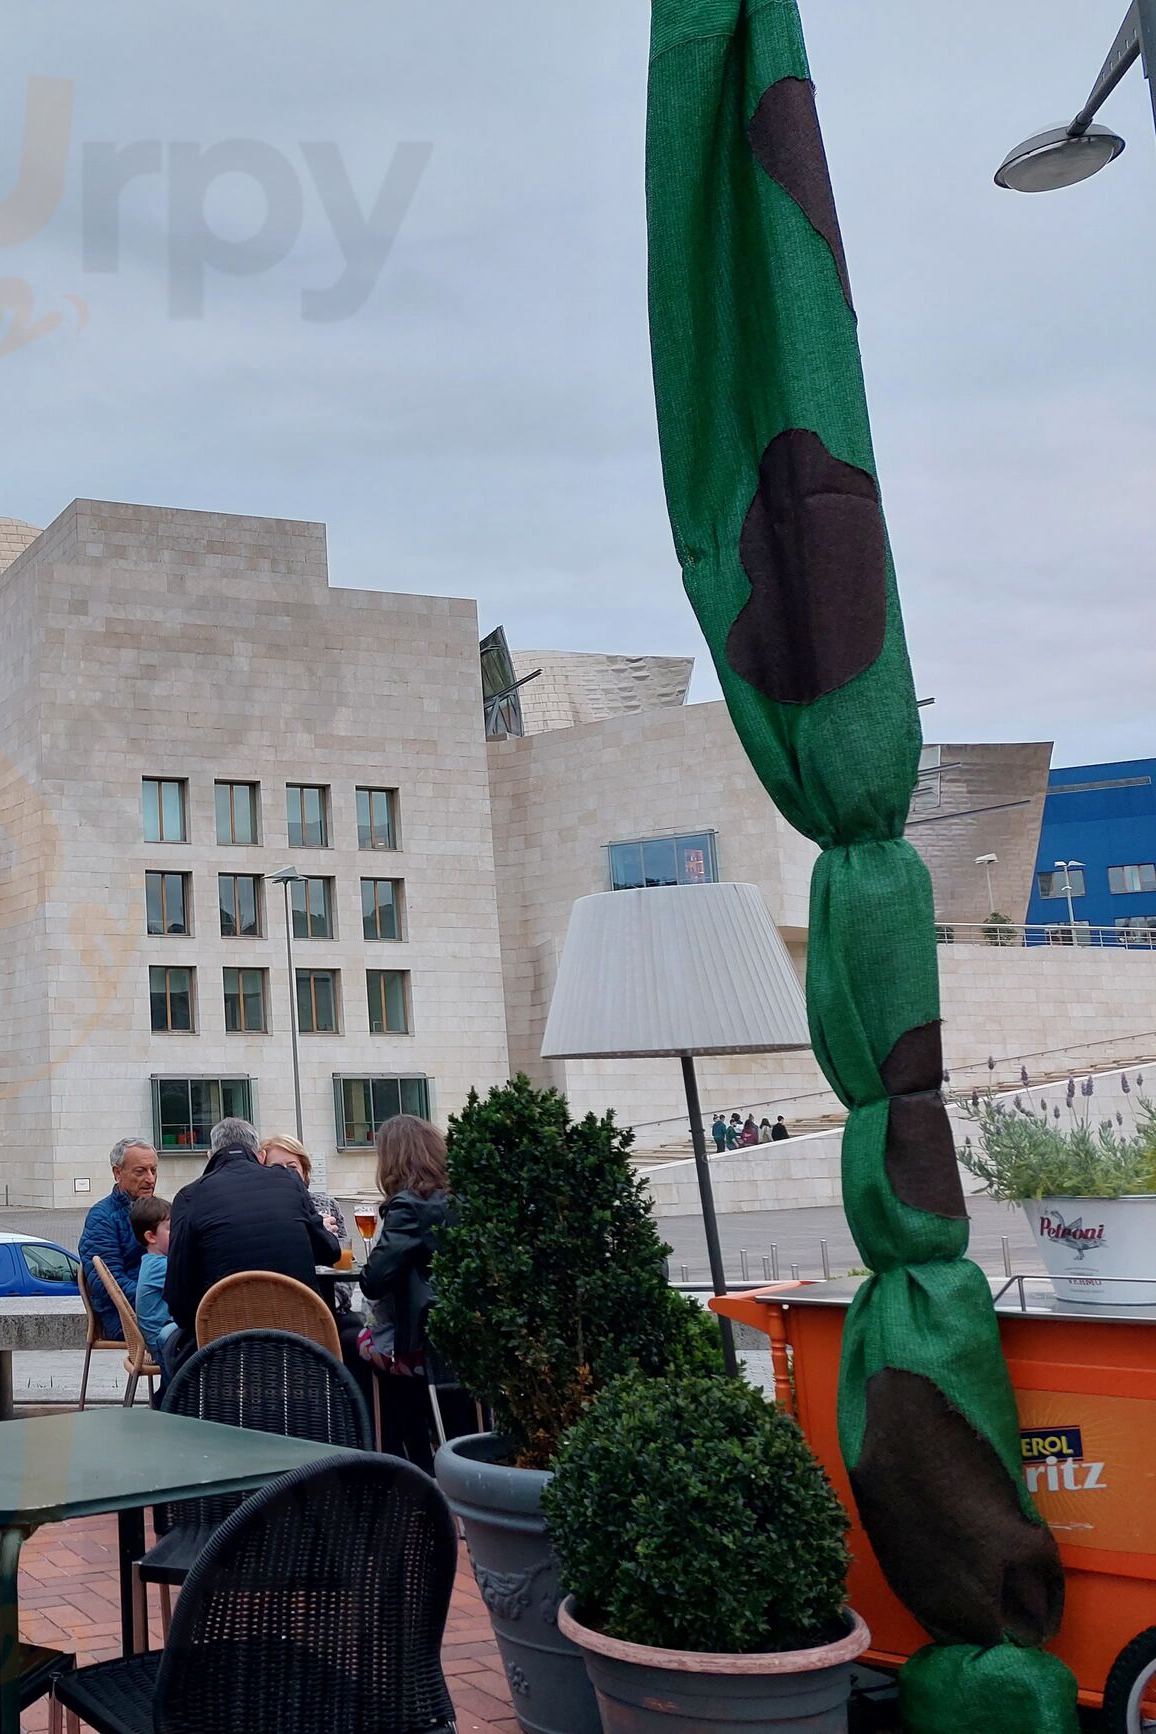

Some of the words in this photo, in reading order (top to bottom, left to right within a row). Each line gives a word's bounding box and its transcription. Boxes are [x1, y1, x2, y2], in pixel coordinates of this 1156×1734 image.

[1040, 1216, 1104, 1239] Petroni
[1021, 1435, 1074, 1456] EROL
[1026, 1456, 1108, 1492] ritz
